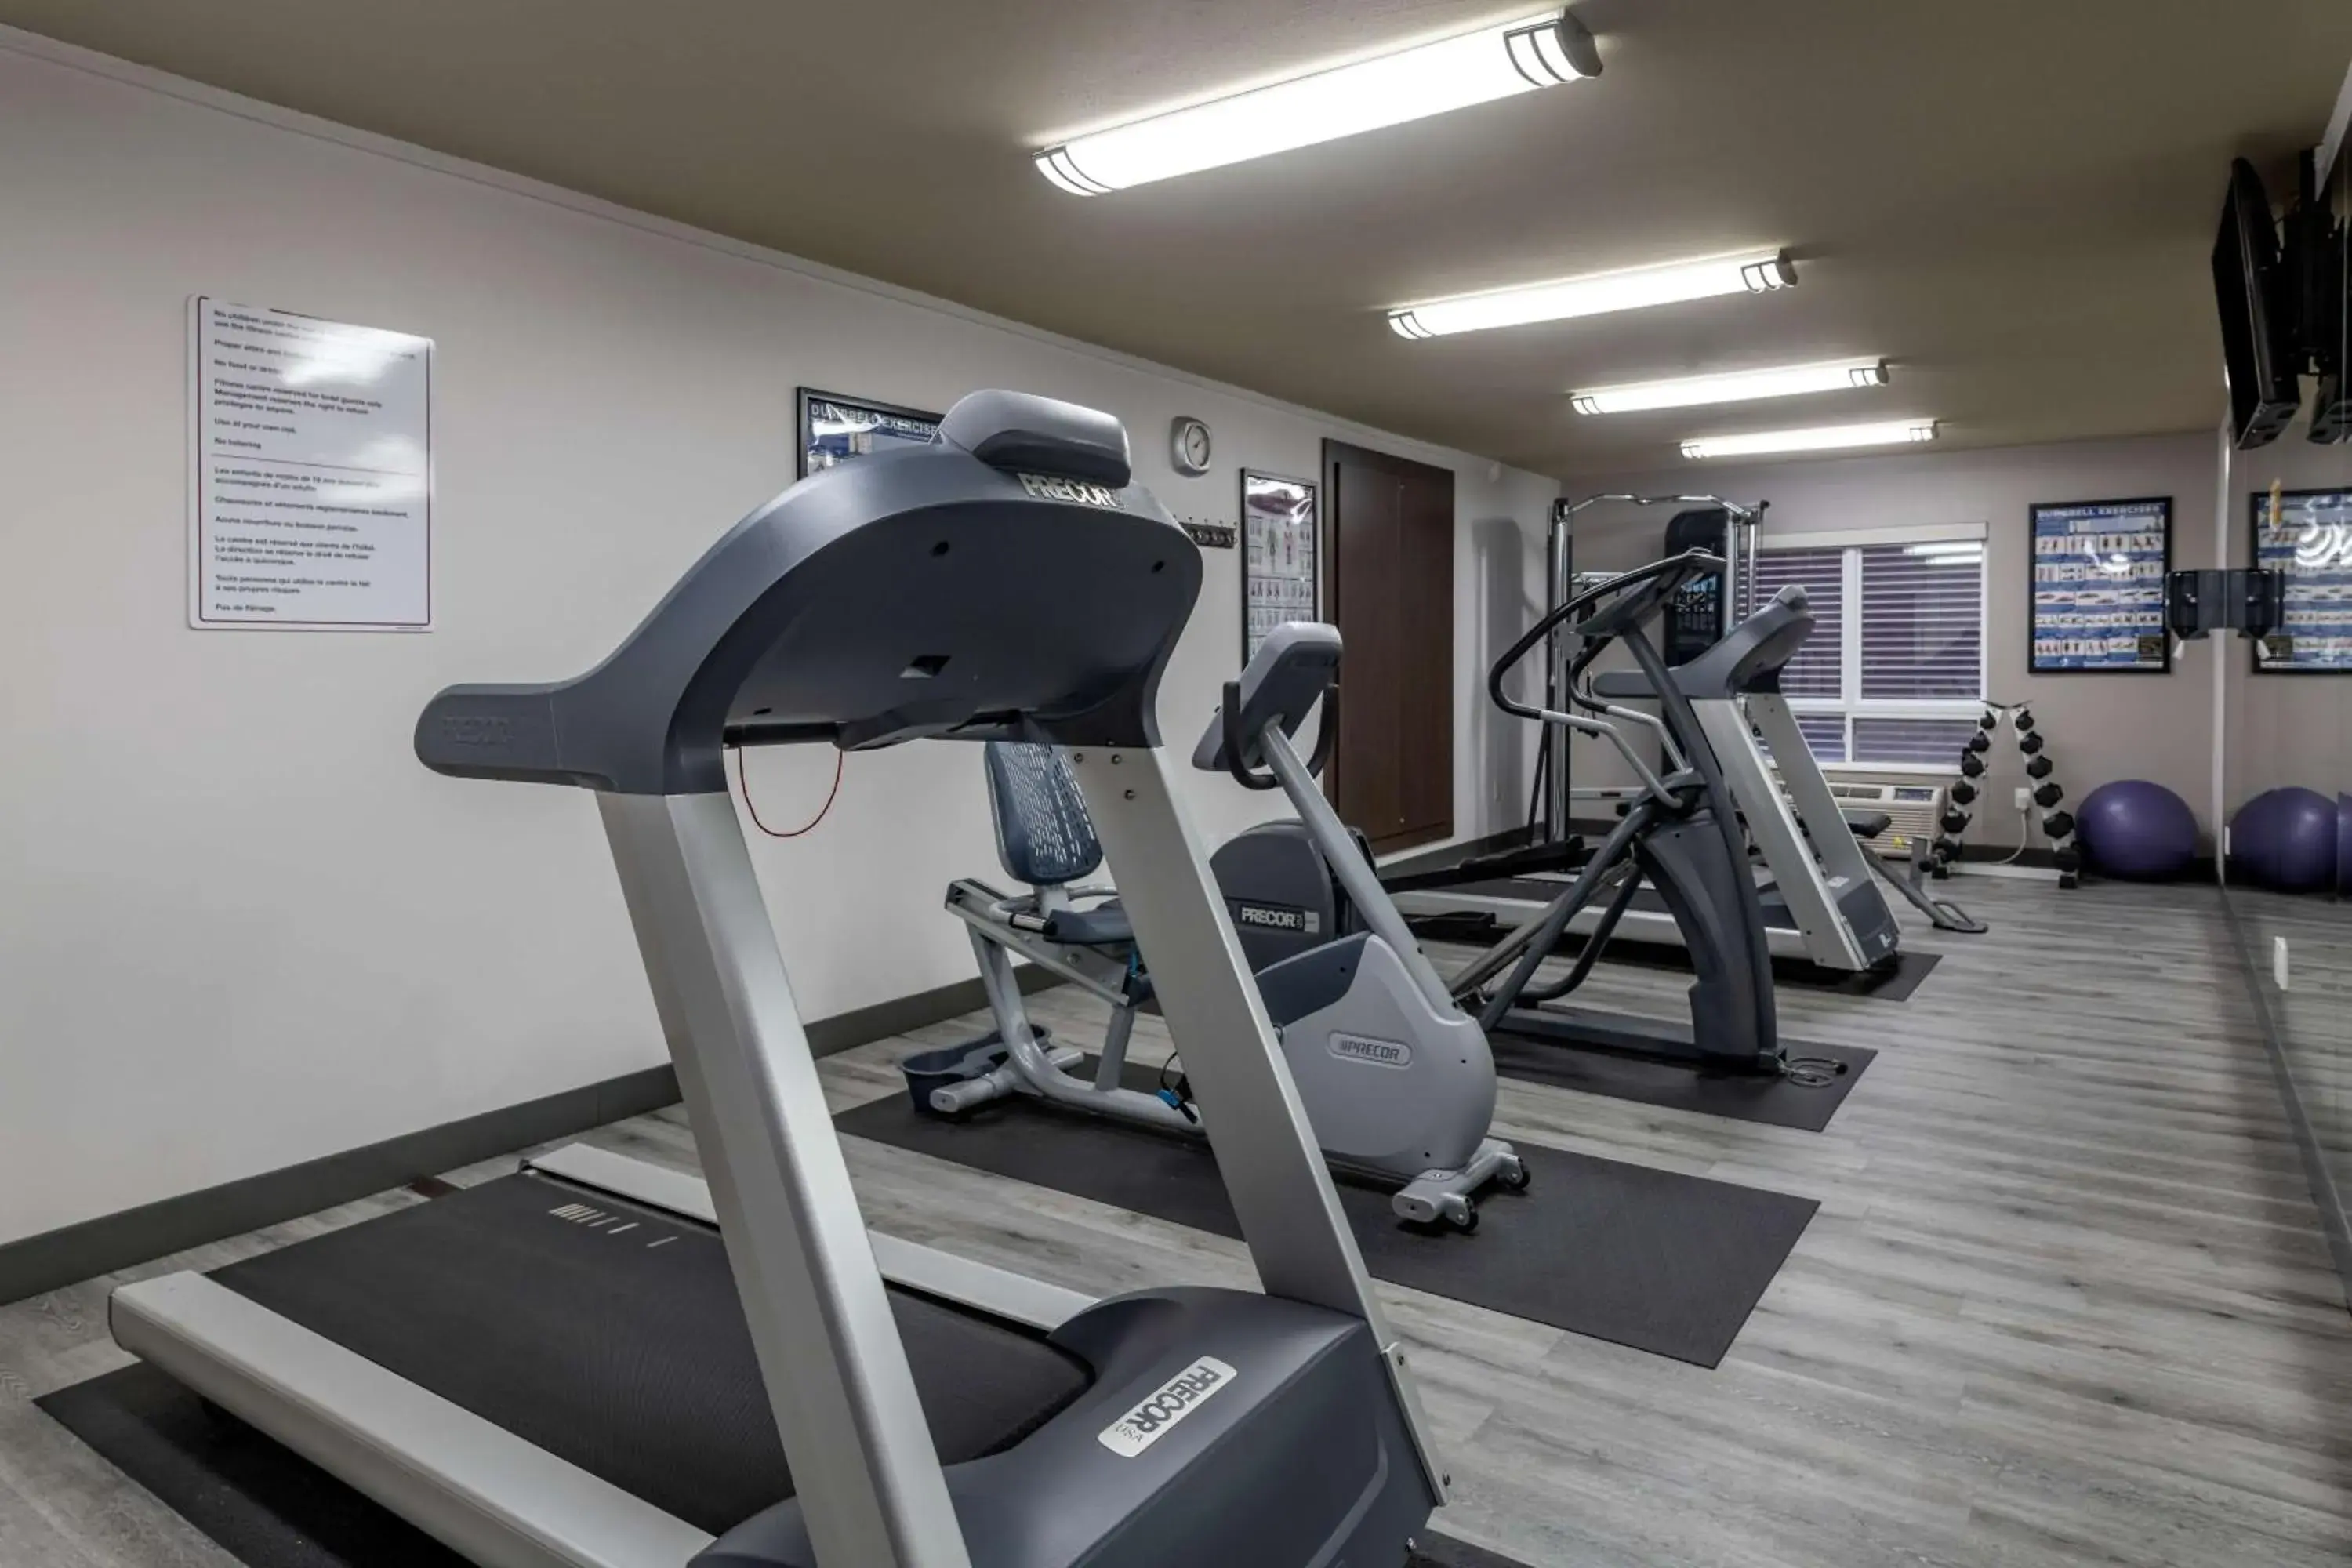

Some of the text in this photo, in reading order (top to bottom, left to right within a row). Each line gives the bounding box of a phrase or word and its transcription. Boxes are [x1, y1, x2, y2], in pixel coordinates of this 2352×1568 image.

[1017, 472, 1117, 508] PRECOR
[1241, 906, 1295, 928] PRECOR
[1347, 1040, 1400, 1060] PRECOR
[1125, 1364, 1222, 1434] PRECOR
